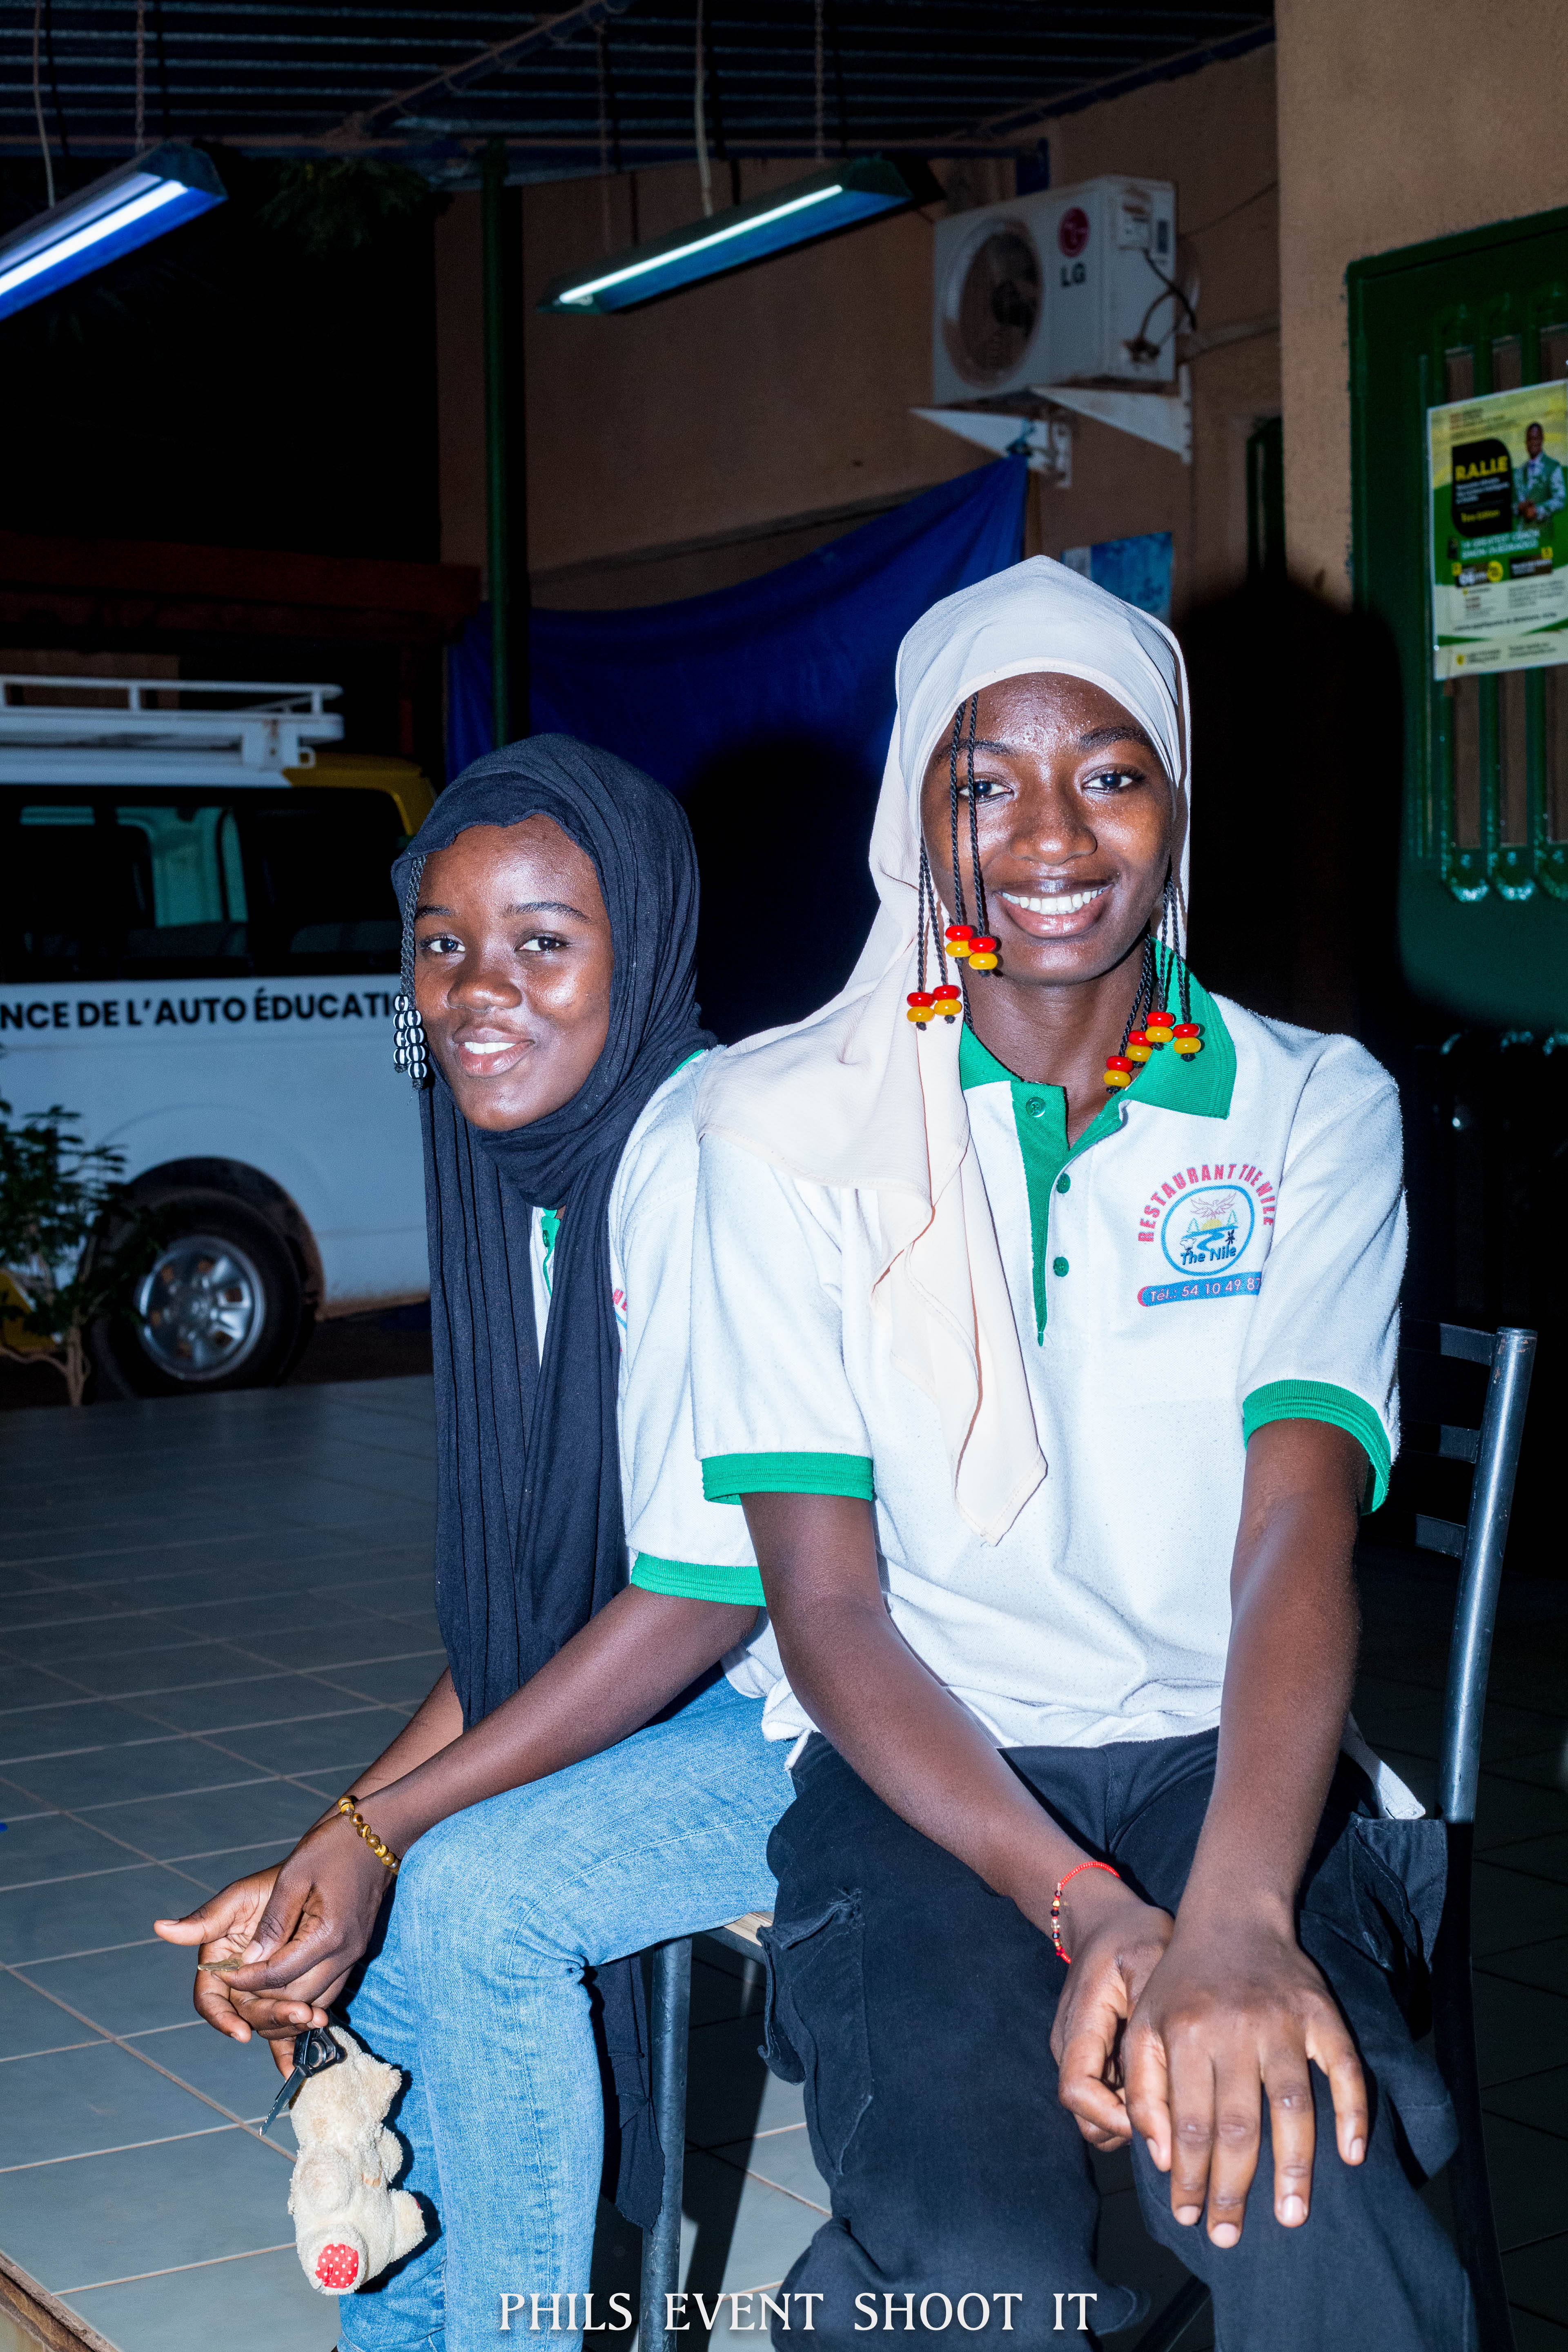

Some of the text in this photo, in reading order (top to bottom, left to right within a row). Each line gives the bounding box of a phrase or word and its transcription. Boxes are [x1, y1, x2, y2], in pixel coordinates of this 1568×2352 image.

[1061, 263, 1086, 288] LG
[77, 1000, 119, 1028] DE
[252, 987, 399, 1022] ÉDUCATI
[1138, 1164, 1276, 1242] RESTAURANT THE NILE
[1180, 1244, 1236, 1265] The Nile
[1181, 1284, 1199, 1297] 54
[1204, 1282, 1221, 1295] 10
[1225, 1278, 1242, 1292] 49
